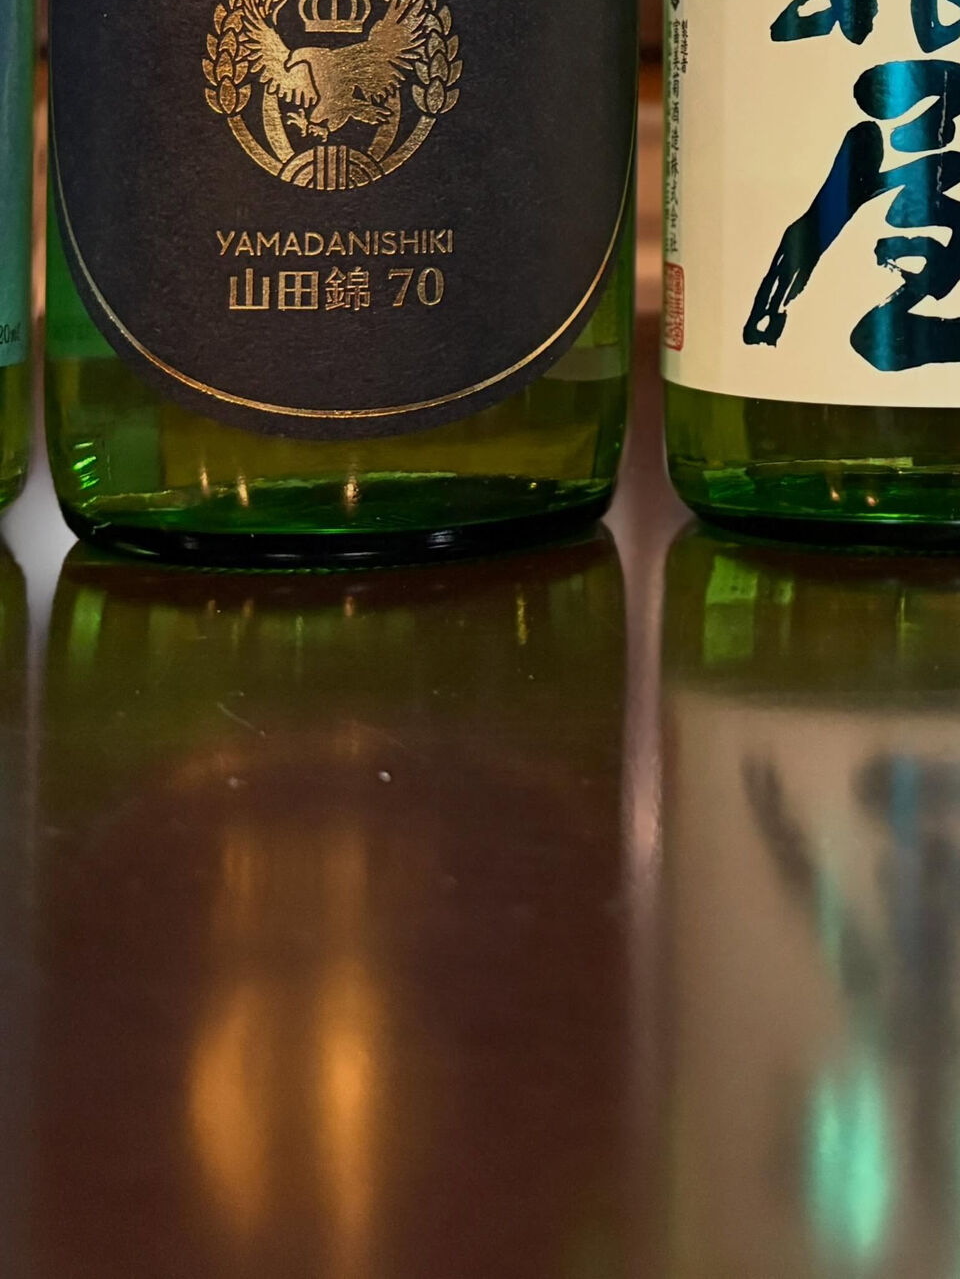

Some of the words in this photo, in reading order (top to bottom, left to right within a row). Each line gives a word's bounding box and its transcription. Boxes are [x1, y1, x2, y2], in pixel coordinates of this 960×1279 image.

[216, 229, 453, 256] YAMADANISHIKI
[229, 266, 370, 310] 山田錦
[388, 267, 444, 307] 70
